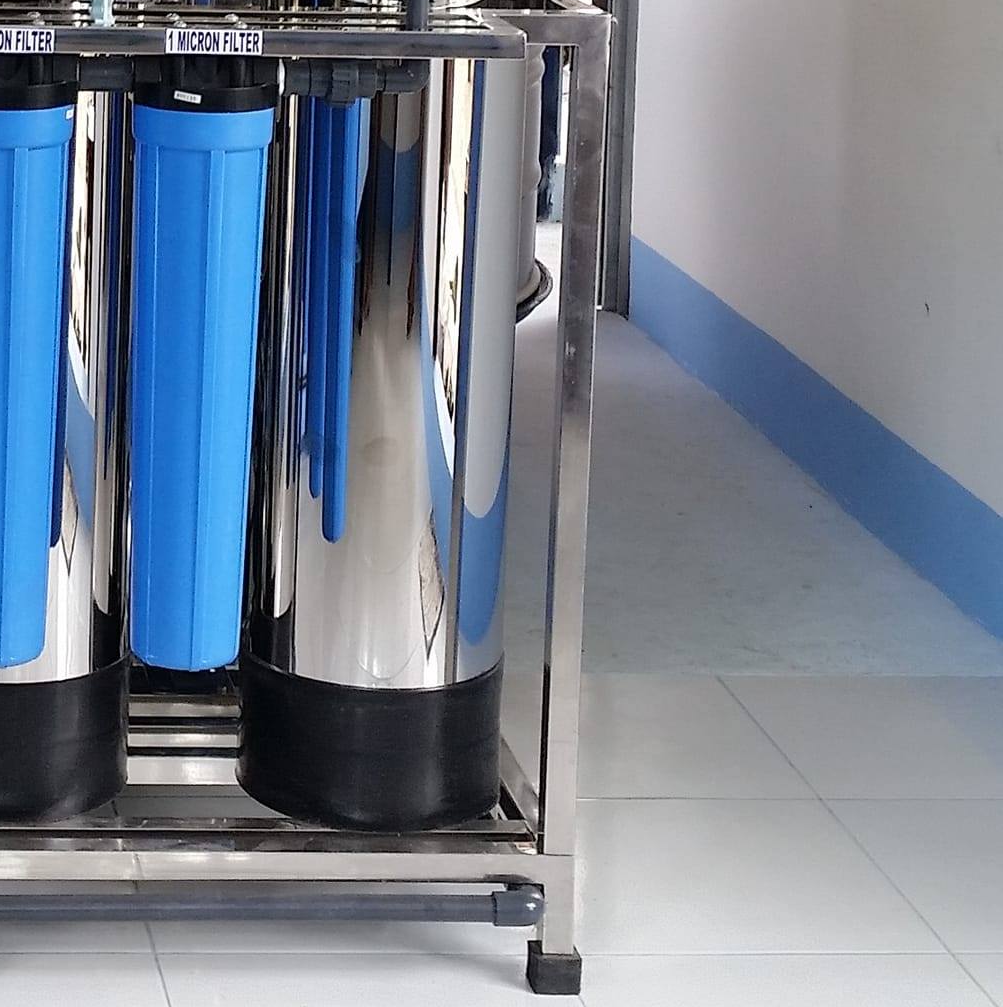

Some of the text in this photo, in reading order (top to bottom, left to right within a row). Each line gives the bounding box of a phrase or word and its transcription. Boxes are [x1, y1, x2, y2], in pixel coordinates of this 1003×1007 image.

[15, 30, 53, 52] FILTER
[167, 30, 260, 53] 1 MICRON FILTER
